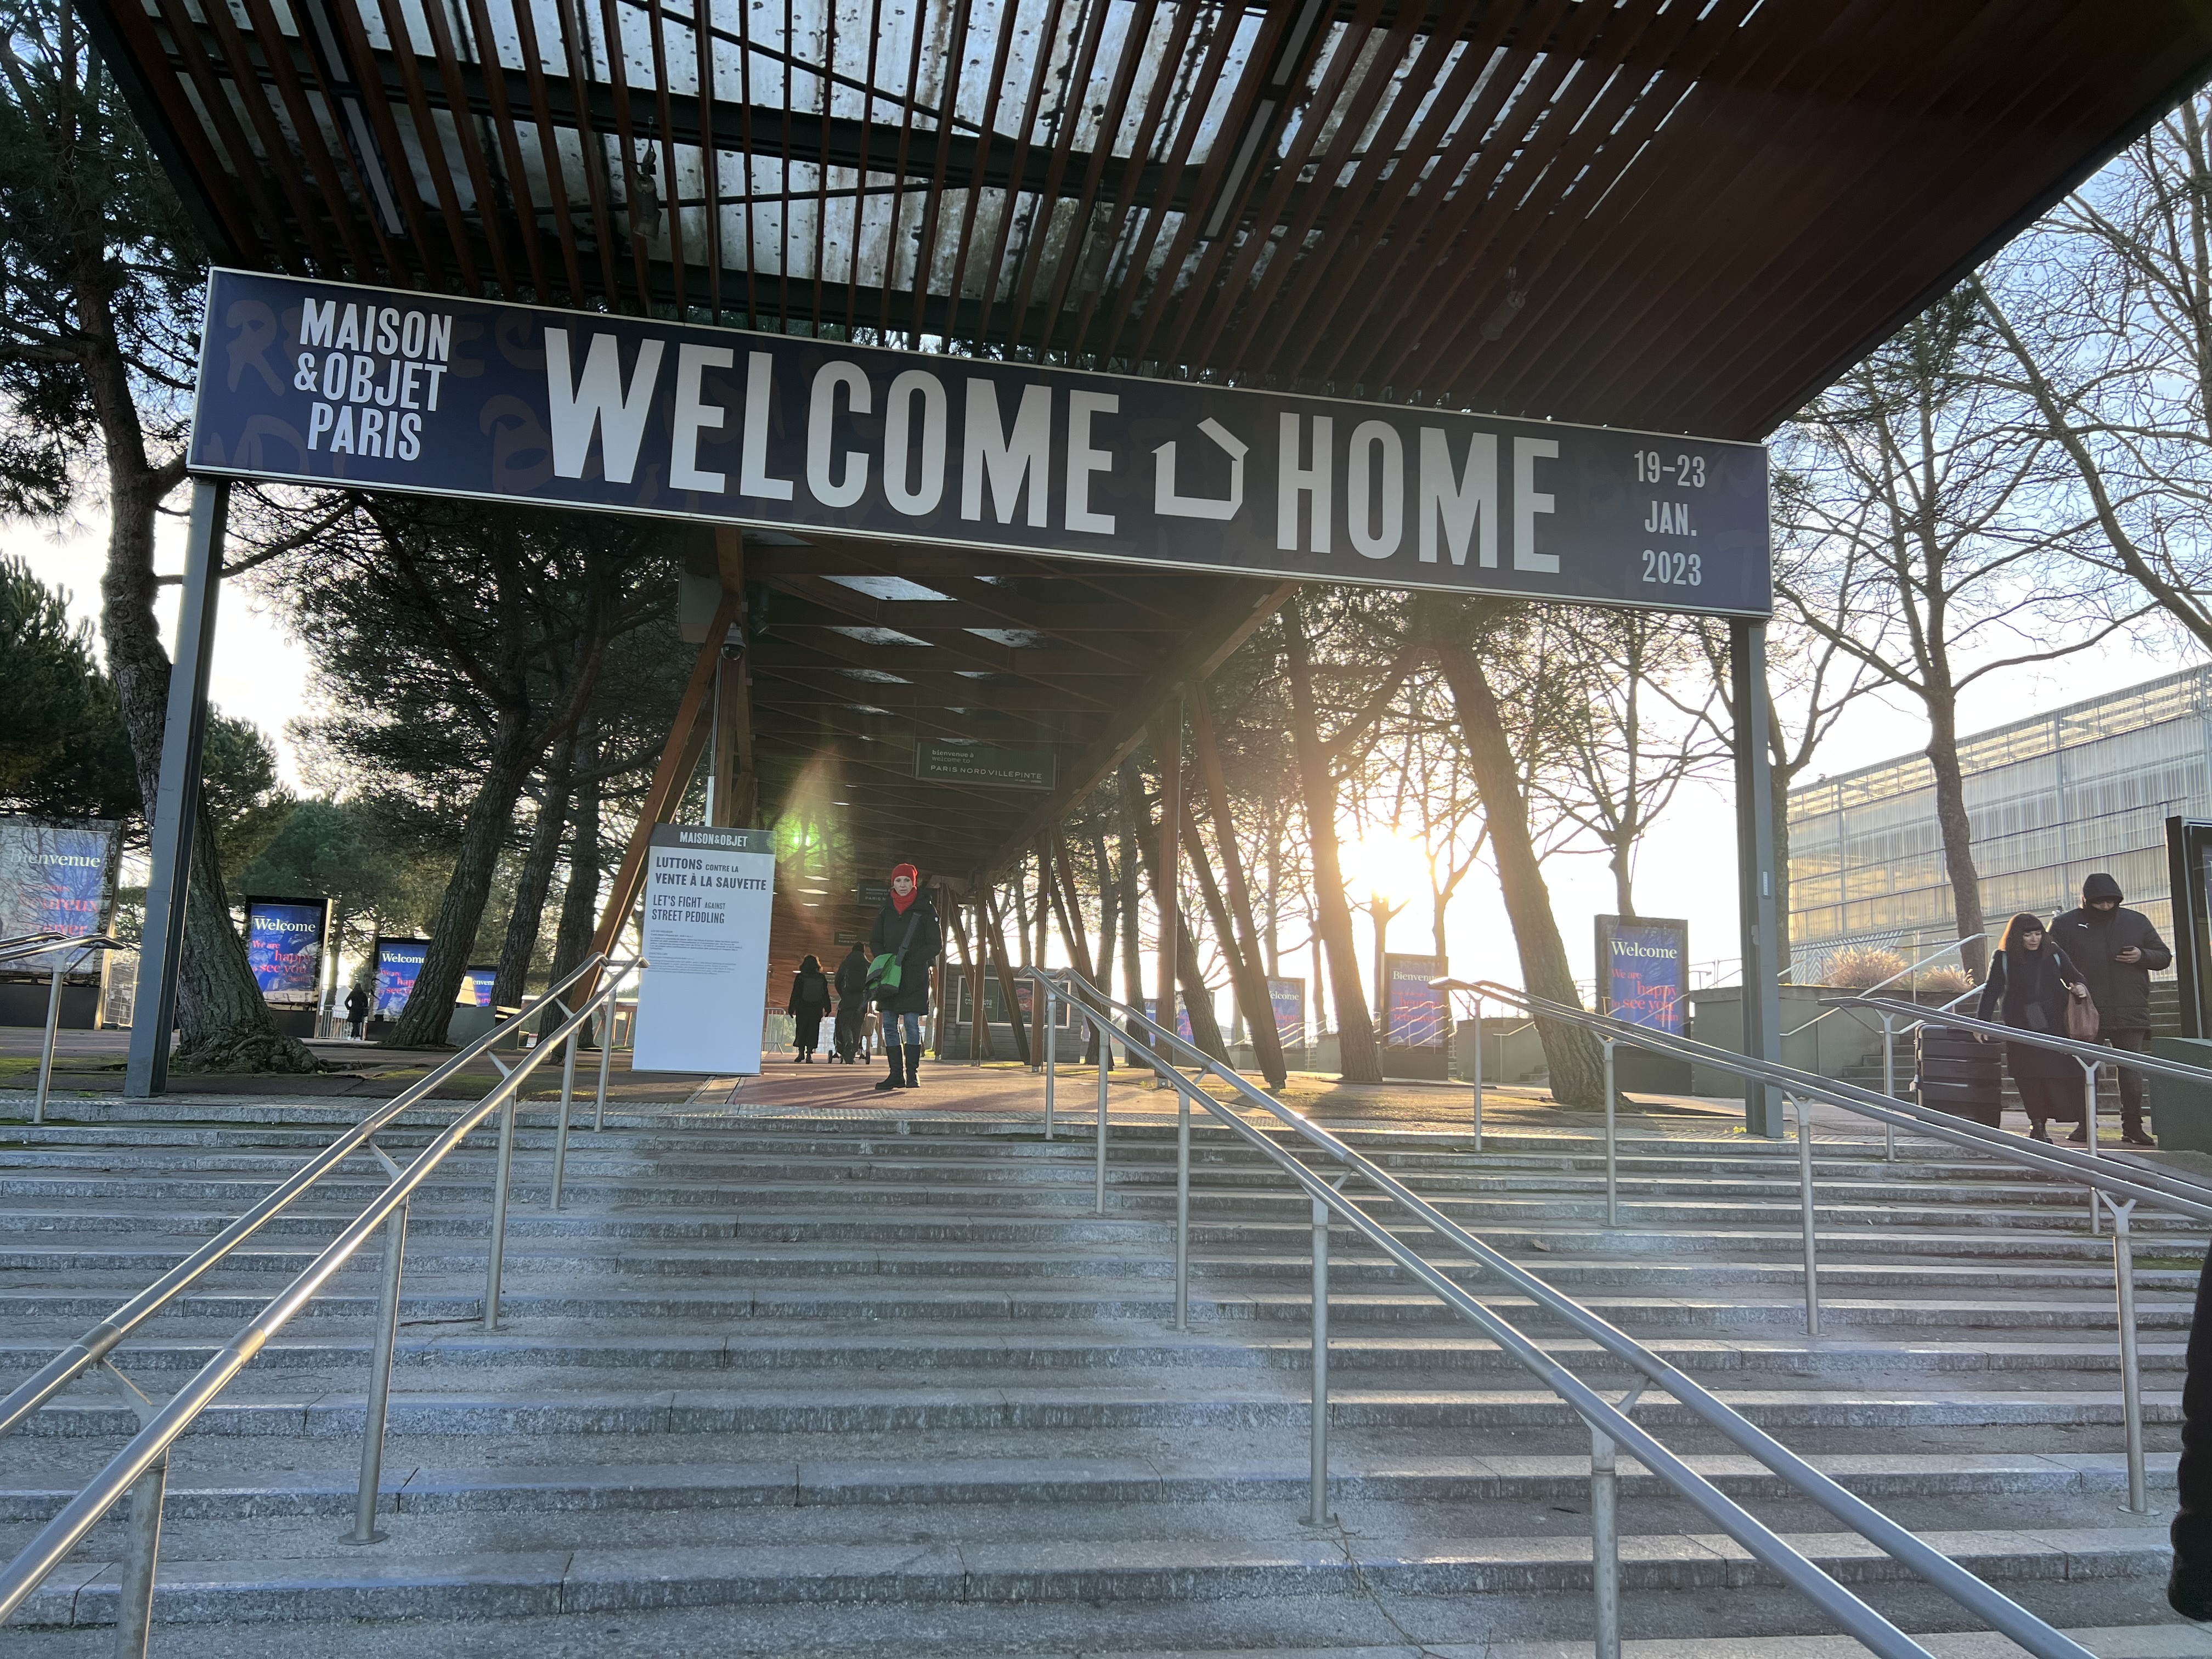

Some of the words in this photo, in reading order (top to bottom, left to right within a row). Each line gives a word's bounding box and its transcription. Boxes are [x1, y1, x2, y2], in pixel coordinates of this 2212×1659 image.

[299, 297, 452, 362] MAISON
[294, 352, 448, 411] &OBJET
[307, 401, 422, 461] PARIS
[544, 327, 1120, 535] WELCOME
[1277, 411, 1560, 574] HOME
[1644, 500, 1697, 537] JAN.
[1641, 548, 1702, 586] 2023
[932, 749, 969, 758] bienvenue
[988, 769, 1042, 780] VILLEPINTE
[679, 831, 748, 848] MAISON&OBJET
[10, 848, 100, 868] Bienvenue
[656, 856, 703, 870] LUTTONS
[705, 864, 730, 872] CONTRE
[655, 873, 687, 885] VENTE
[690, 873, 697, 886] À
[700, 876, 712, 887] LA
[715, 877, 767, 890] SAUVETTE
[653, 894, 675, 907] LET'S
[678, 896, 702, 908] FIGHT
[652, 909, 683, 922] STREET
[685, 911, 725, 924] PEDDLING
[254, 918, 316, 933] Welcome
[1611, 941, 1678, 959] Welcome
[1611, 968, 1627, 979] We
[1627, 972, 1643, 980] are
[1637, 980, 1677, 1000] happy
[1622, 999, 1646, 1009] see
[1647, 1000, 1674, 1013] you
